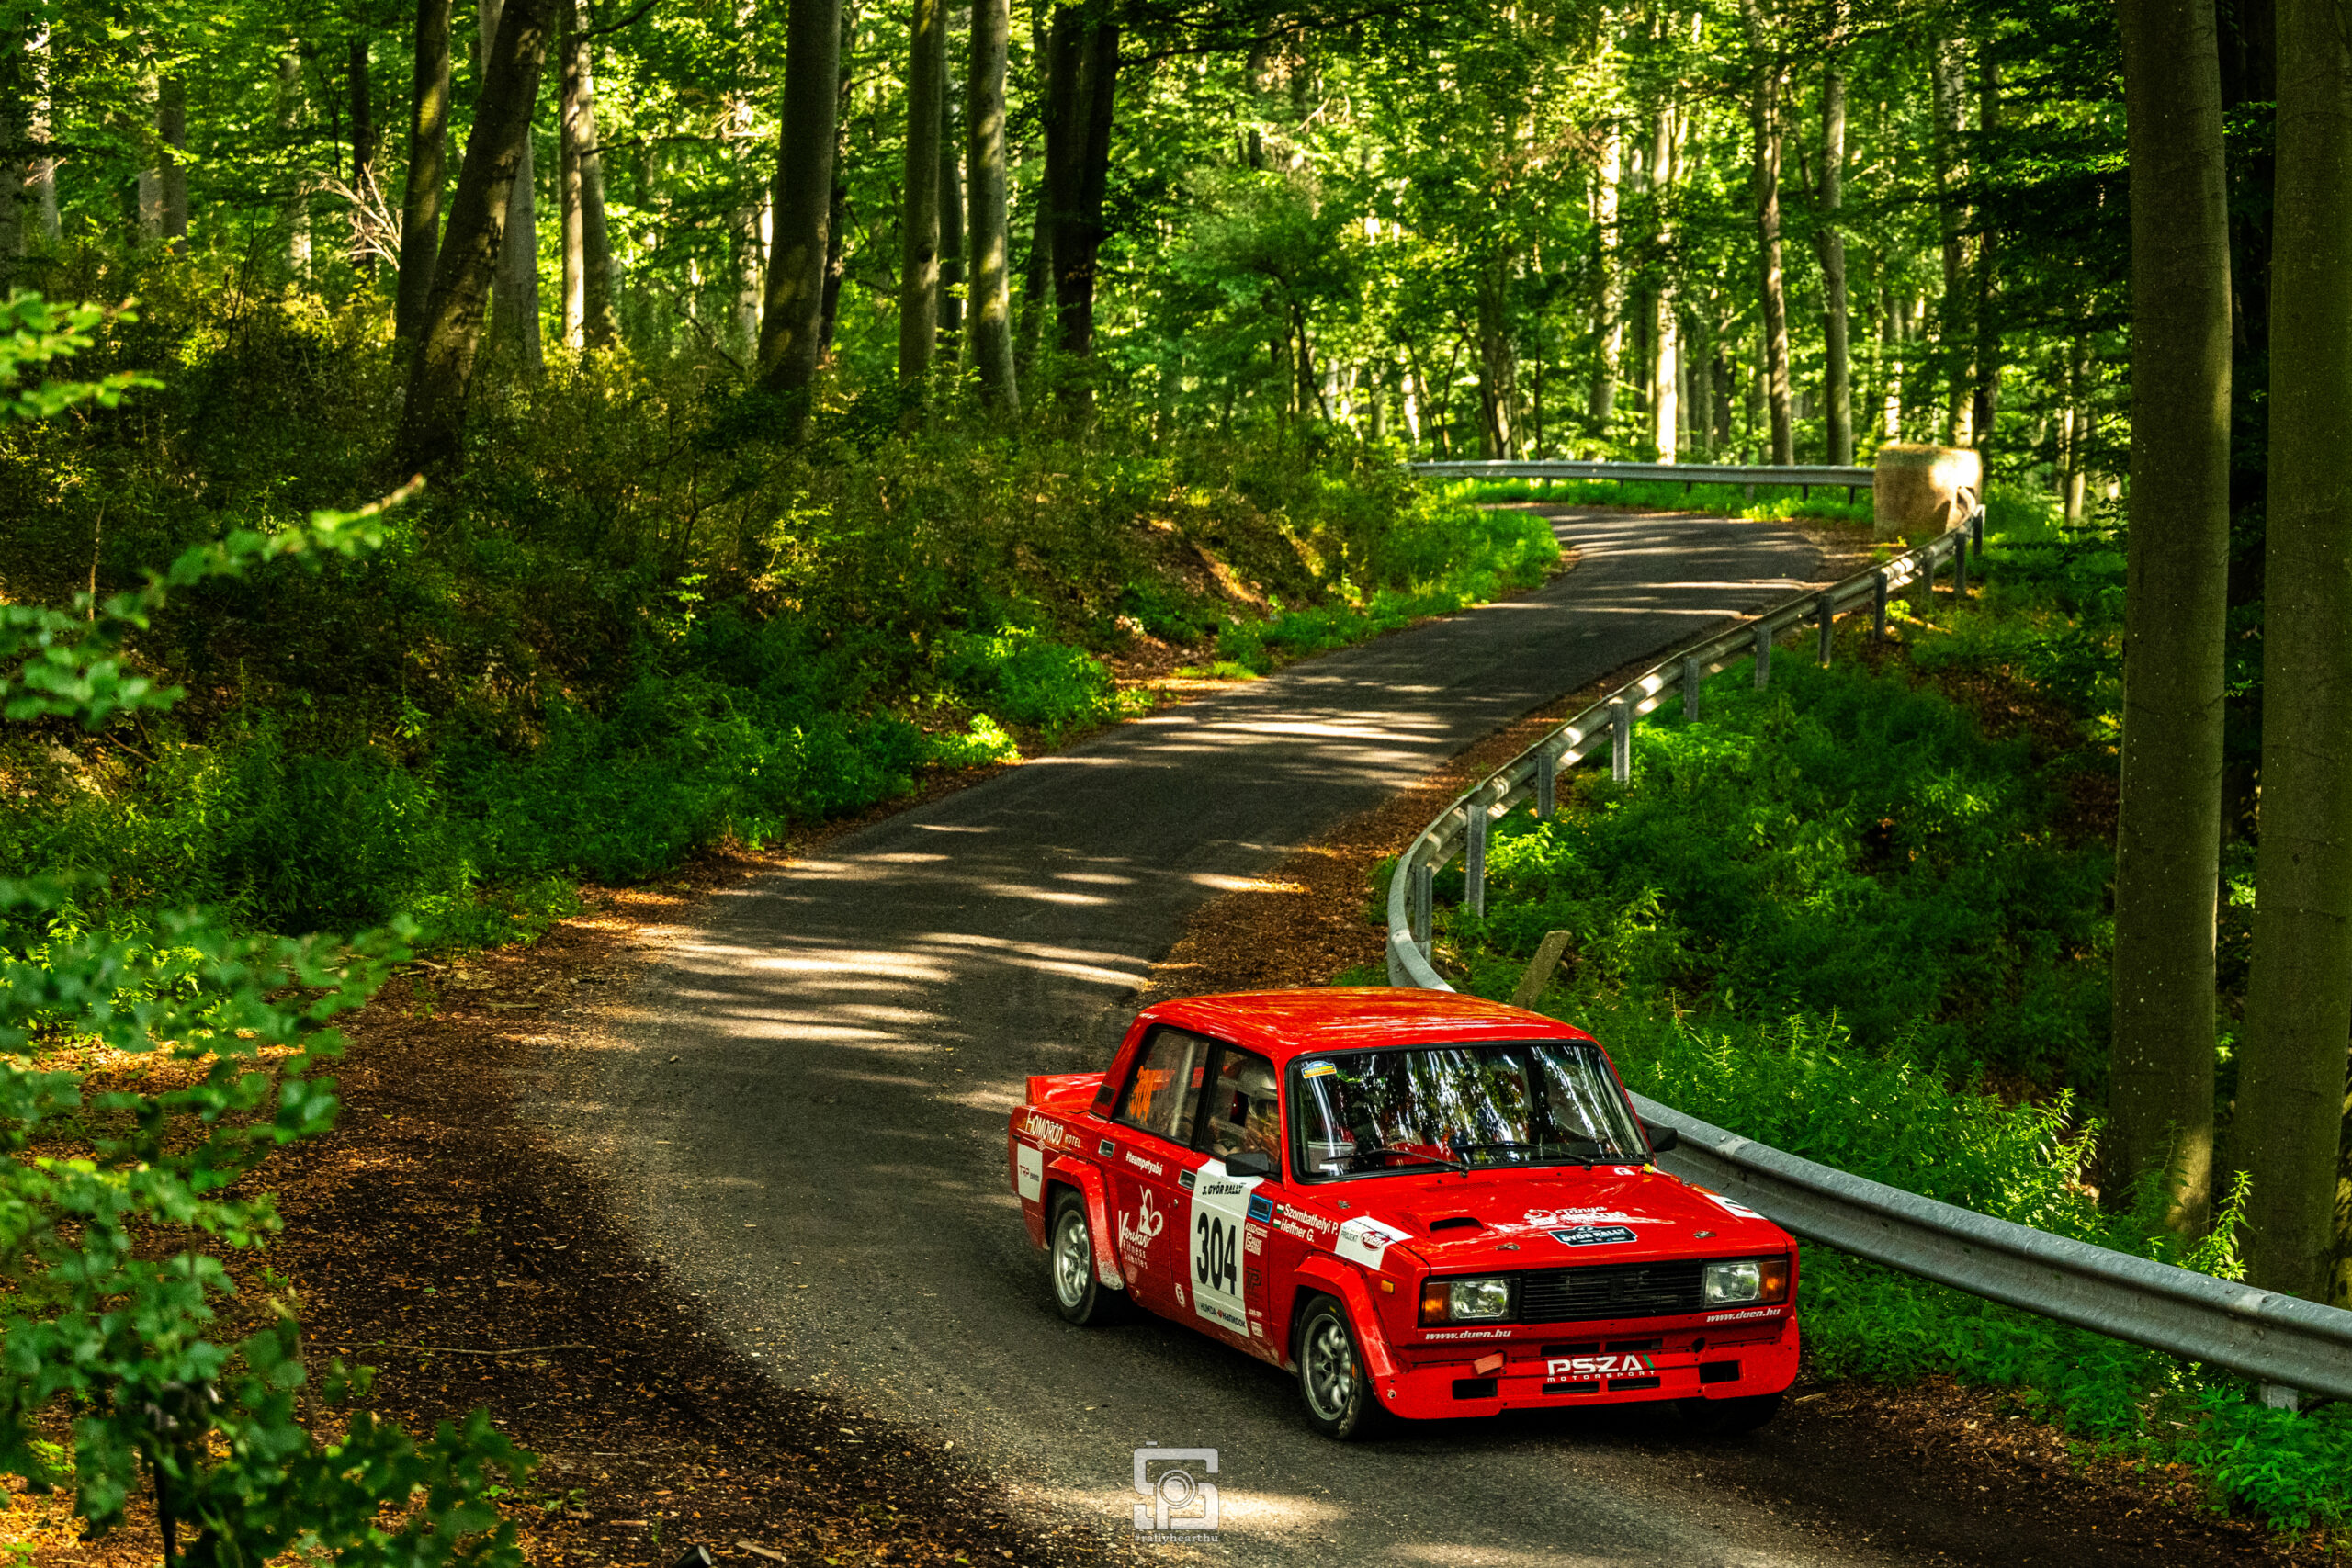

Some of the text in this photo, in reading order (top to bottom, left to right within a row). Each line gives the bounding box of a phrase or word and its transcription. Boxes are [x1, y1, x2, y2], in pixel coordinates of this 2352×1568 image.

[1065, 1134, 1081, 1148] HOTEL
[1208, 1181, 1224, 1195] GYŐR
[1224, 1183, 1244, 1195] RALLY
[1283, 1203, 1331, 1235] Szombathelyi
[1331, 1222, 1339, 1236] P.
[1280, 1218, 1306, 1239] Heffner
[1306, 1229, 1315, 1243] G.
[1341, 1230, 1358, 1242] PROJEKT
[1593, 1228, 1625, 1238] RALLY
[1196, 1212, 1237, 1295] 304
[1706, 1307, 1781, 1323] www.duen.hu
[1425, 1329, 1512, 1340] www.duen.hu
[1547, 1354, 1644, 1376] PSZA
[1547, 1370, 1655, 1382] MOTORSPORT
